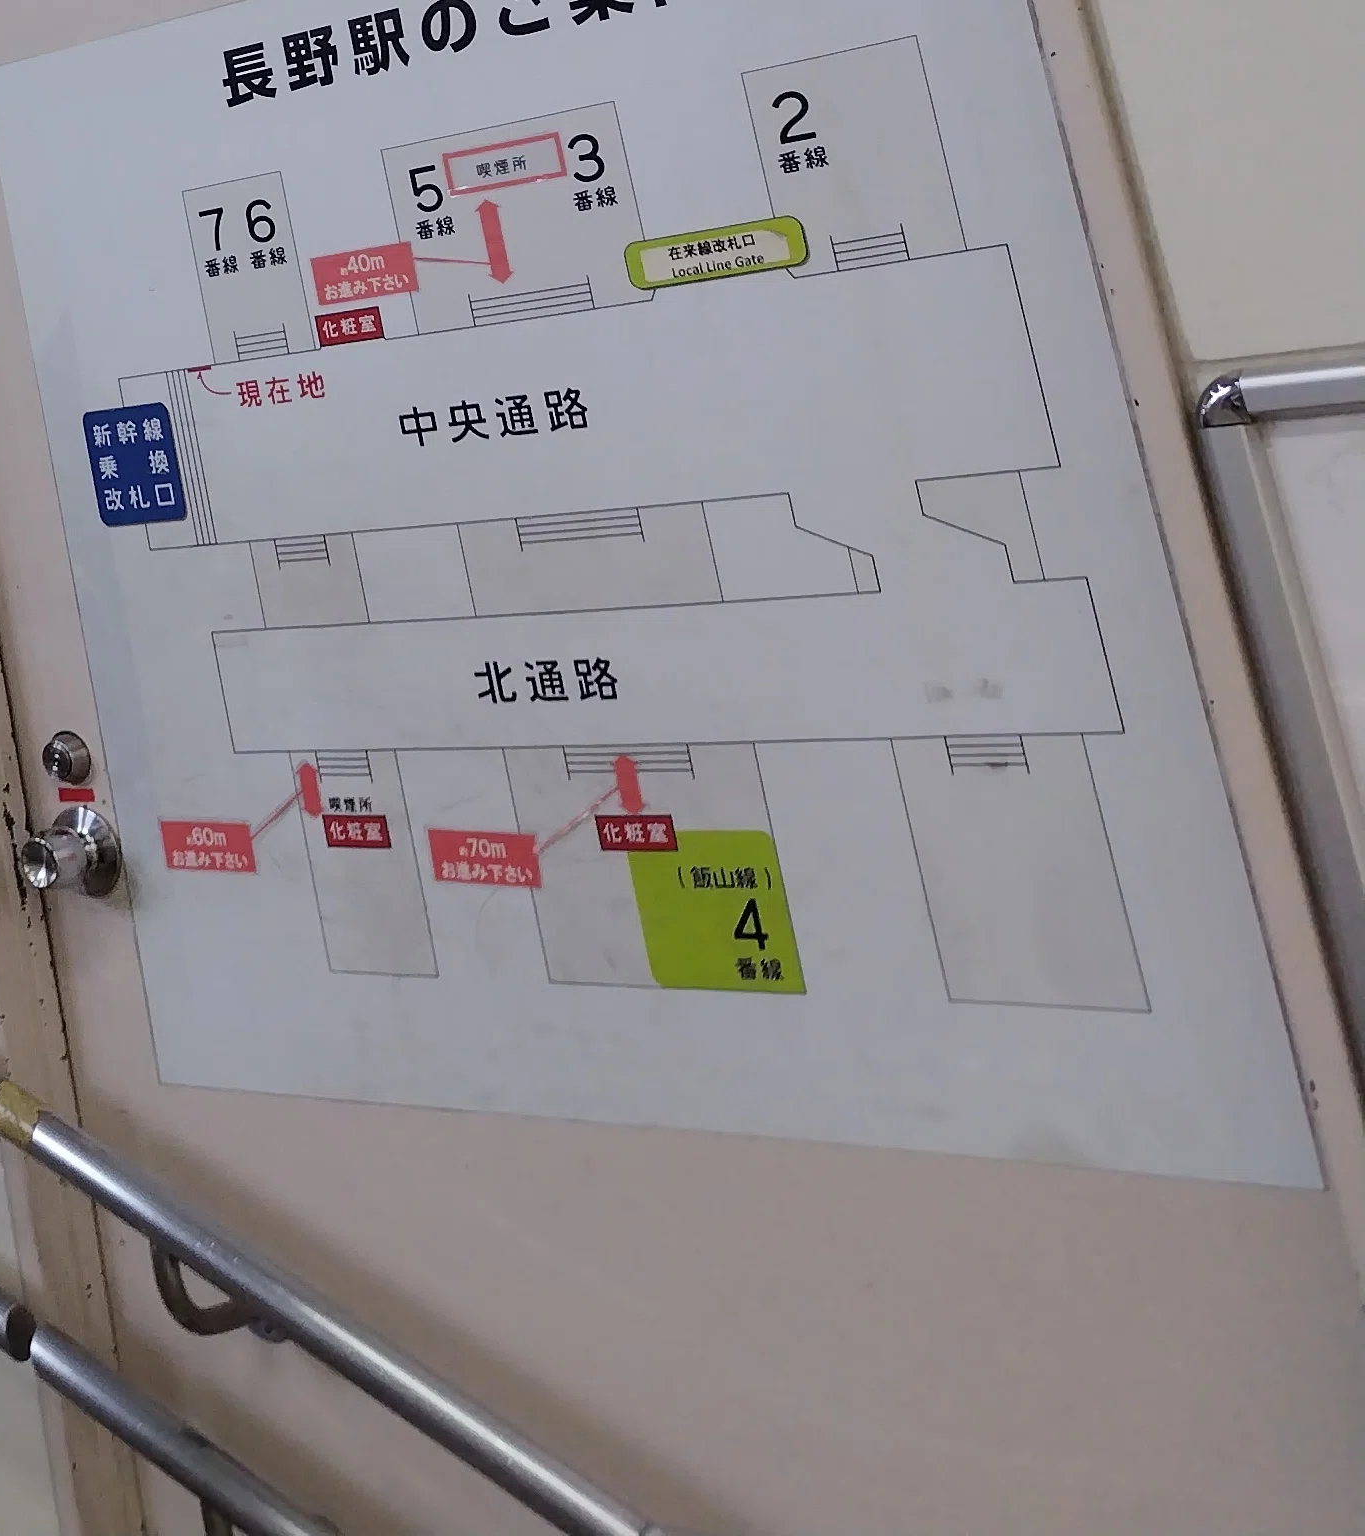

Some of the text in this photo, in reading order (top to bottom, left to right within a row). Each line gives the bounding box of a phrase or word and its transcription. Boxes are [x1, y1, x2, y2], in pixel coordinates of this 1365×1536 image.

[771, 90, 818, 145] 2
[476, 155, 528, 179] 喫煙所
[568, 133, 606, 183] 3
[777, 145, 830, 175] 番線
[408, 164, 444, 213] 5
[573, 186, 619, 212] 番線
[198, 207, 224, 252] 7
[245, 199, 276, 243] 6
[415, 216, 456, 240] 番線
[249, 246, 288, 270] 番線
[668, 234, 756, 261] 在来線改札口
[204, 255, 239, 278] 番線
[671, 254, 765, 278] Local Line Gate
[323, 273, 409, 301] お進み下さい
[322, 314, 377, 339] 化粧室
[236, 370, 326, 408] 現在地
[397, 387, 590, 448] 中央通路
[92, 417, 164, 448] 新幹線
[104, 482, 176, 511] 改札口
[475, 656, 620, 706] 北通路
[329, 820, 383, 842] 化粧室
[602, 822, 669, 844] 化粧室
[171, 849, 249, 870] お進み下さい
[441, 861, 533, 884] お進み下さい
[733, 897, 769, 951] 4
[735, 957, 785, 981] 番線
